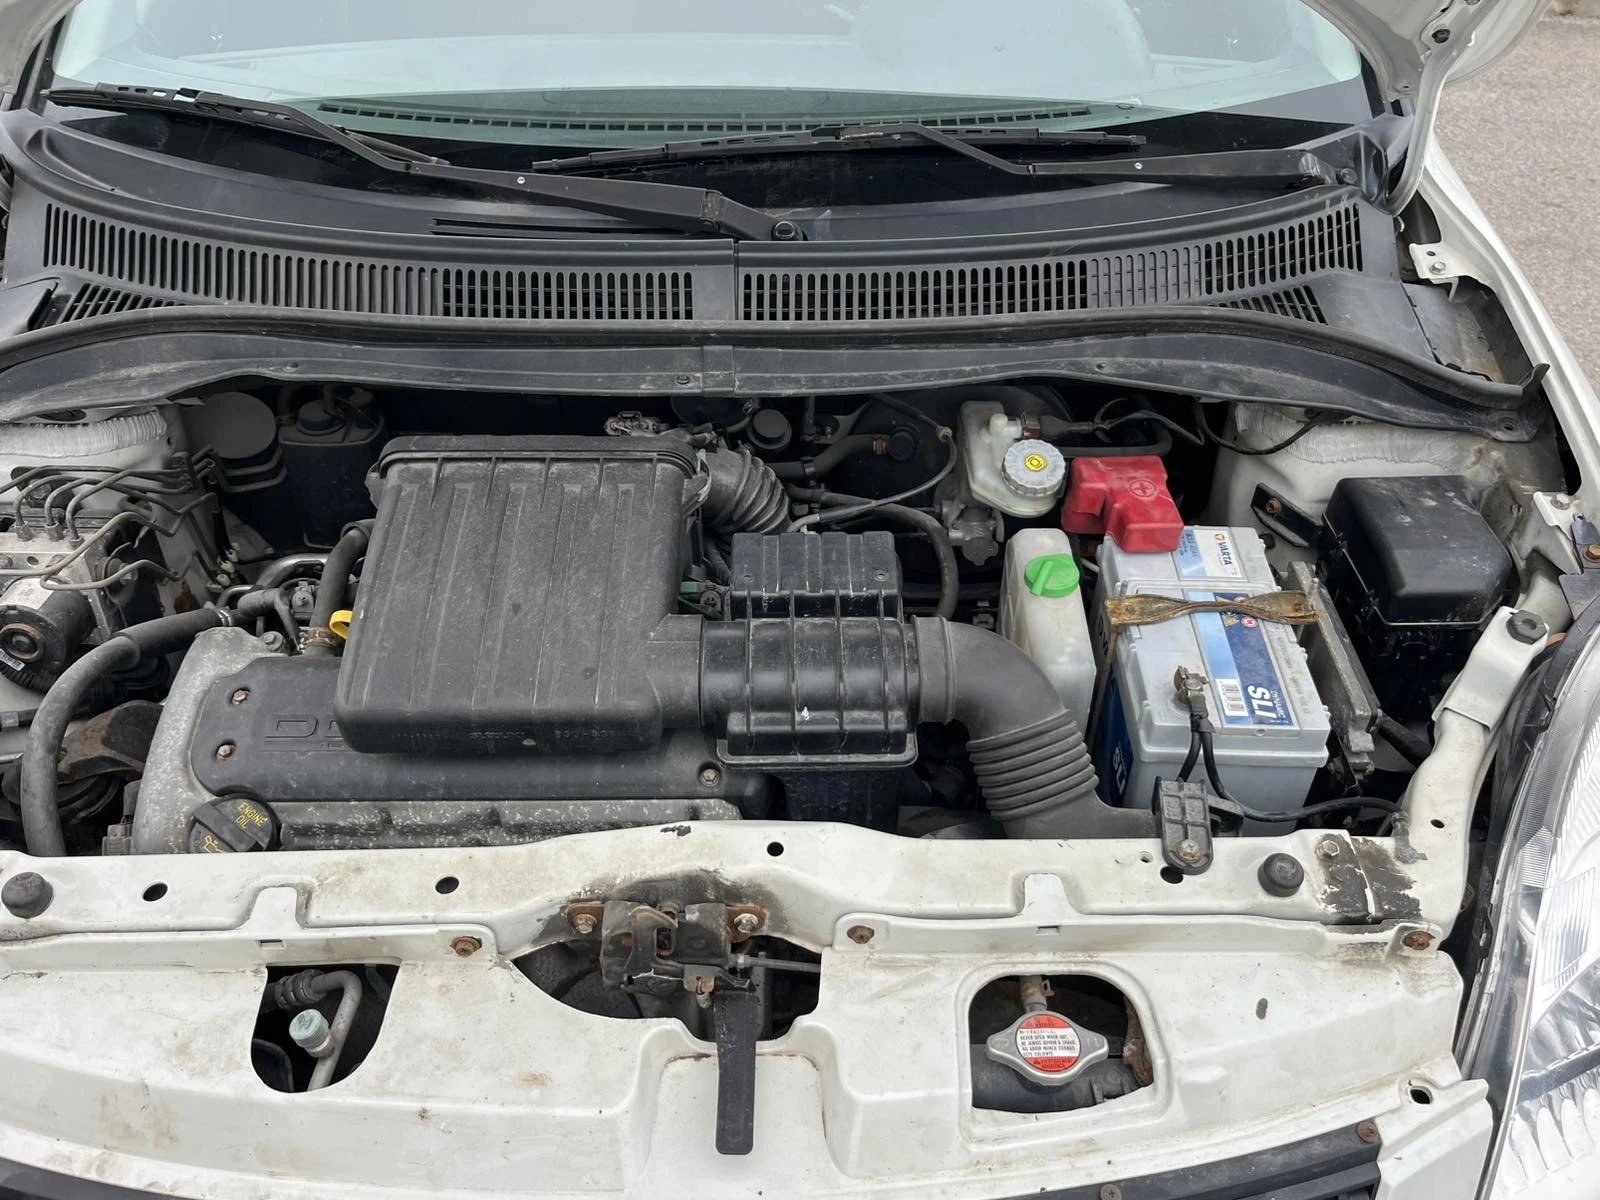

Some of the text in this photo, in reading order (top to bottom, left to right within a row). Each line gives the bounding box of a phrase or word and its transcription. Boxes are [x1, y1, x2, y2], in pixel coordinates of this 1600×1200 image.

[1218, 541, 1232, 566] VARTA
[1247, 685, 1277, 719] SLI
[235, 814, 250, 829] OIL
[238, 802, 269, 827] ENGINE
